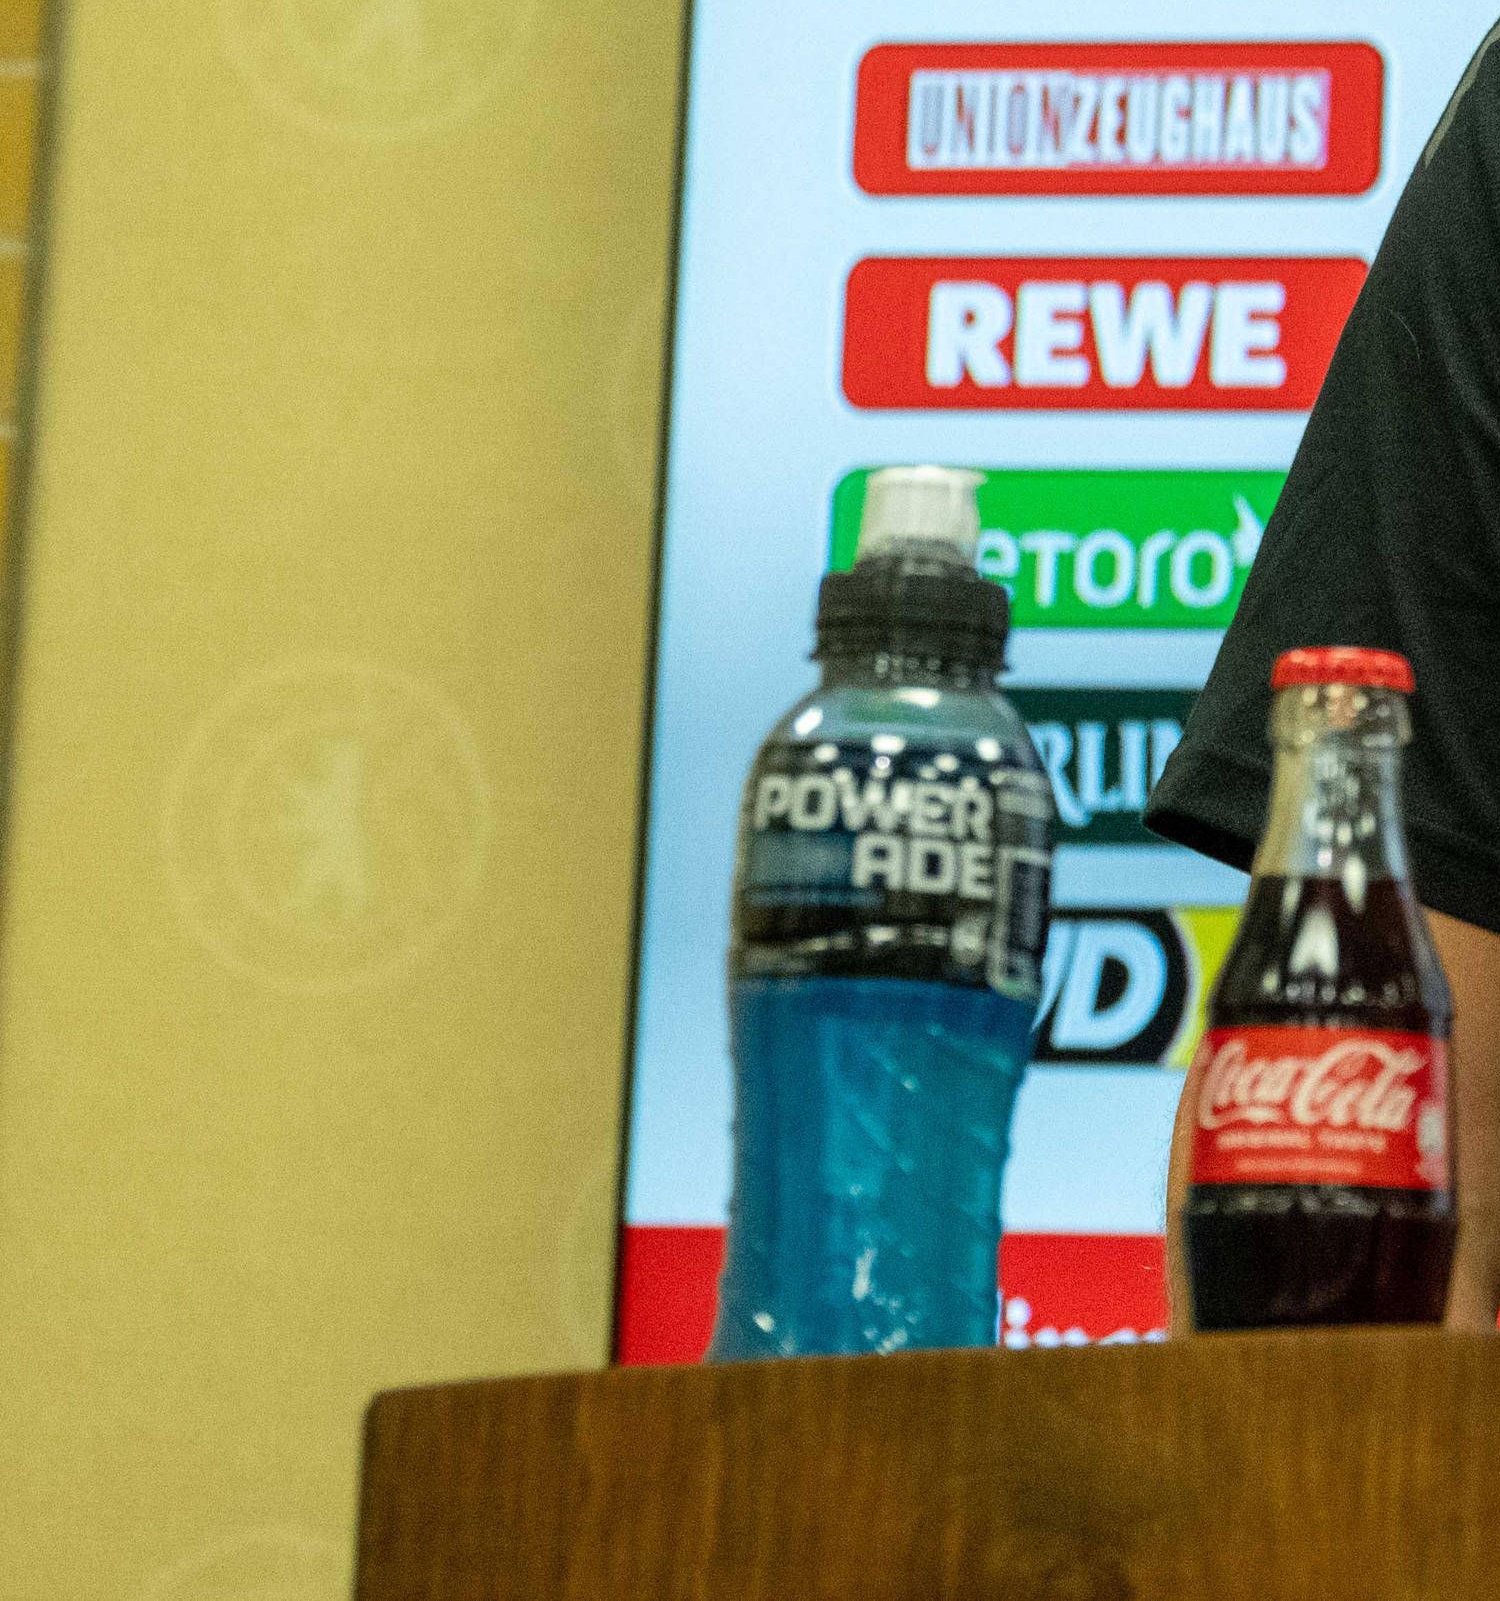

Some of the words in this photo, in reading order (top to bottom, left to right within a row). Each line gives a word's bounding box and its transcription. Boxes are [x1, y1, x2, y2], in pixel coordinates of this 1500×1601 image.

[926, 280, 1285, 389] REWE
[753, 771, 995, 842] POWER
[852, 832, 995, 899] ADE
